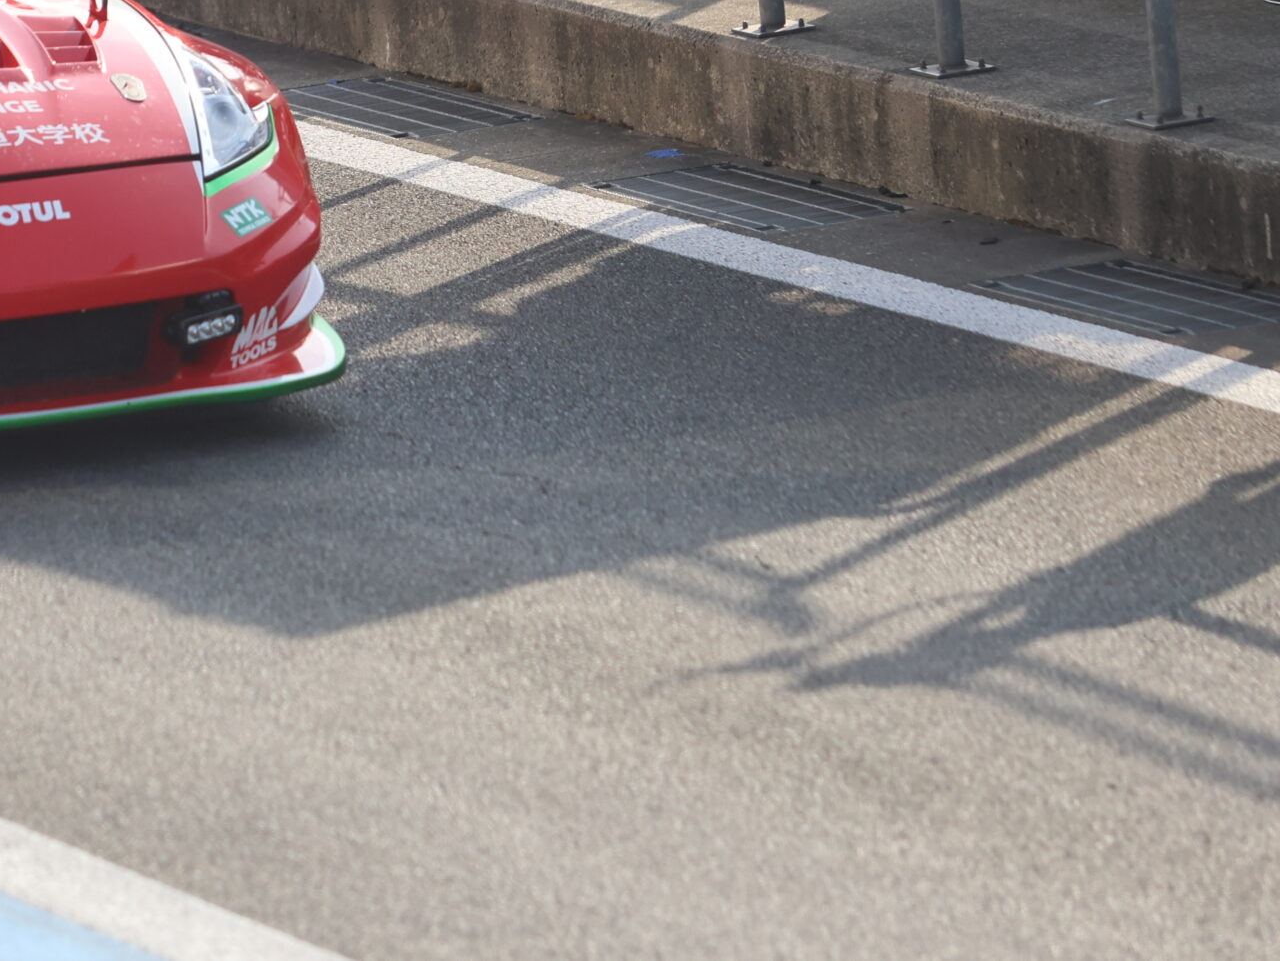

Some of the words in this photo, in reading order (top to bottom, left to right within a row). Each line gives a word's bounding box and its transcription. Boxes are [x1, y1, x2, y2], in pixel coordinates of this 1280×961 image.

[223, 199, 265, 229] NTK
[231, 306, 278, 354] MAC
[230, 336, 277, 369] TOOLS
